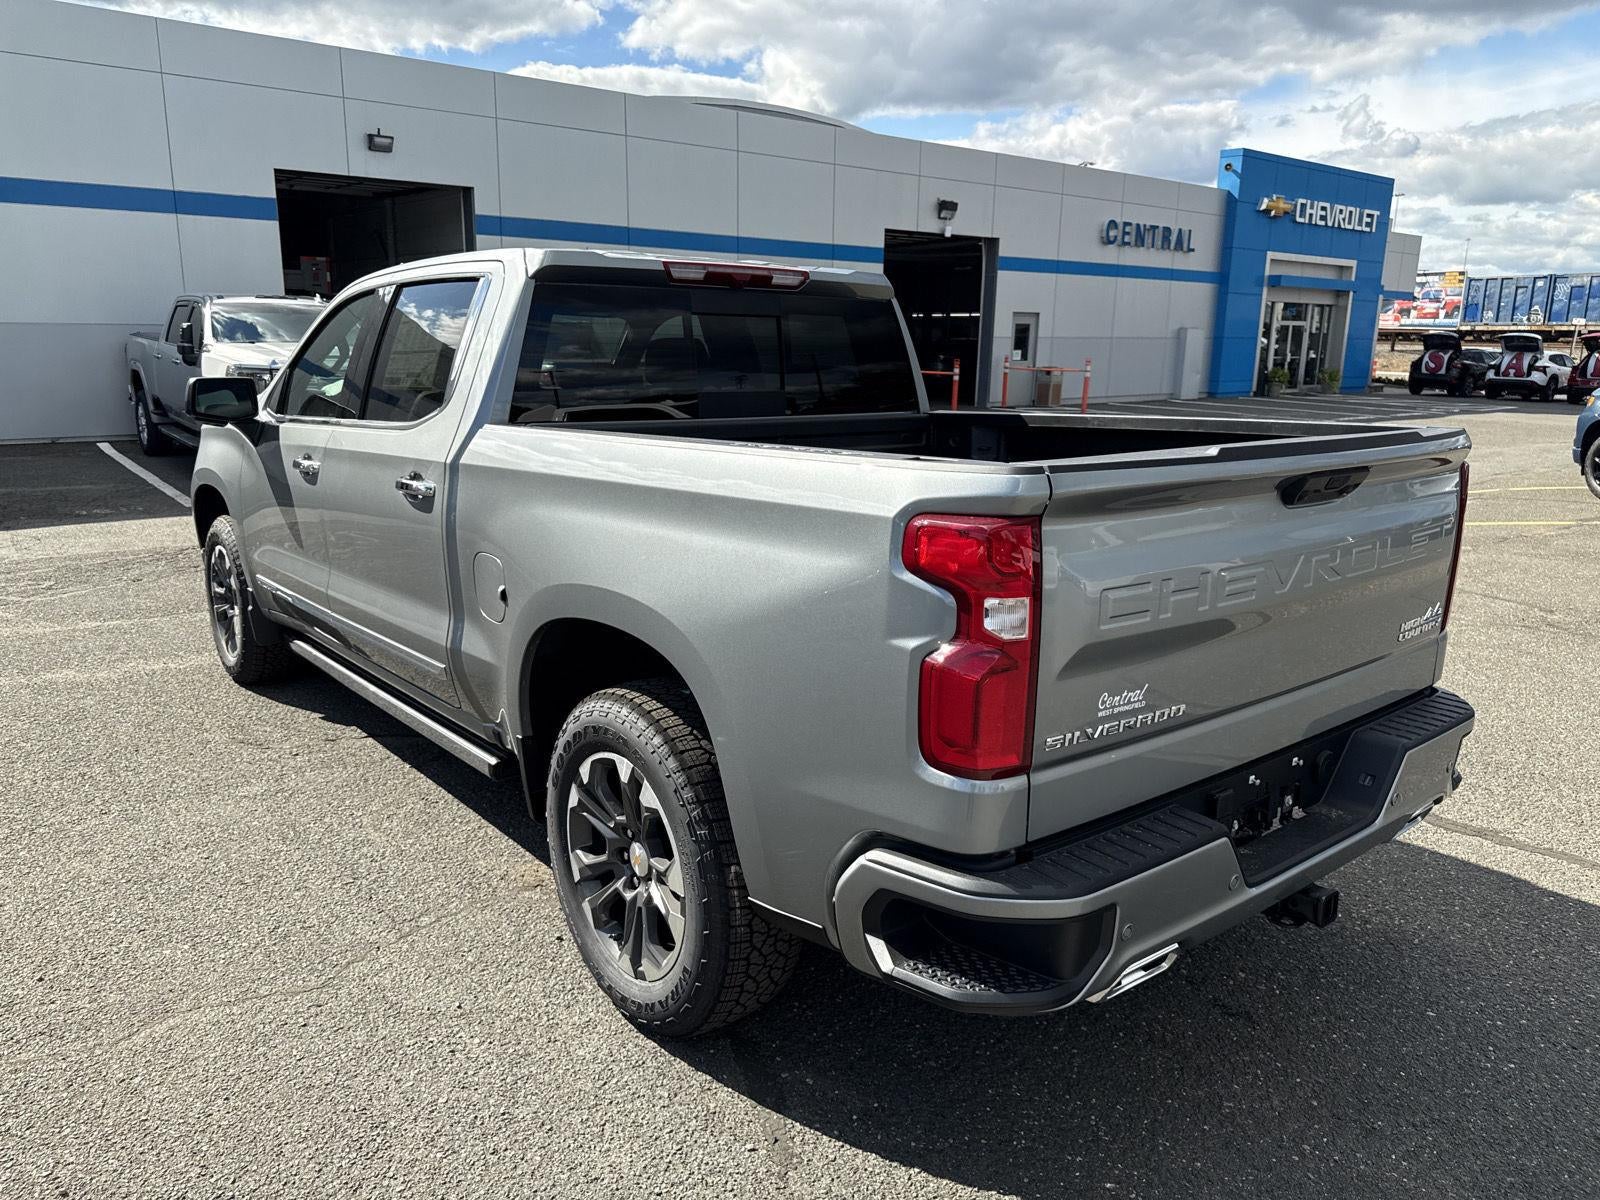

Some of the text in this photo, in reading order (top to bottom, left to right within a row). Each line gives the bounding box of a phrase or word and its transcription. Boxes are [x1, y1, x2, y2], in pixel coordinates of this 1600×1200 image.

[1295, 198, 1380, 233] CHEVROLET
[1103, 219, 1195, 252] CENTRAL
[1501, 352, 1525, 378] A
[1099, 511, 1455, 630] CHEVROLET
[1397, 617, 1442, 642] COUNTRY
[1399, 615, 1425, 633] HIGH
[1097, 701, 1146, 718] WEST SPRINGFIELD
[1098, 683, 1149, 709] Central
[1044, 704, 1187, 752] SILVERADO
[551, 723, 647, 791] GOODYEAR
